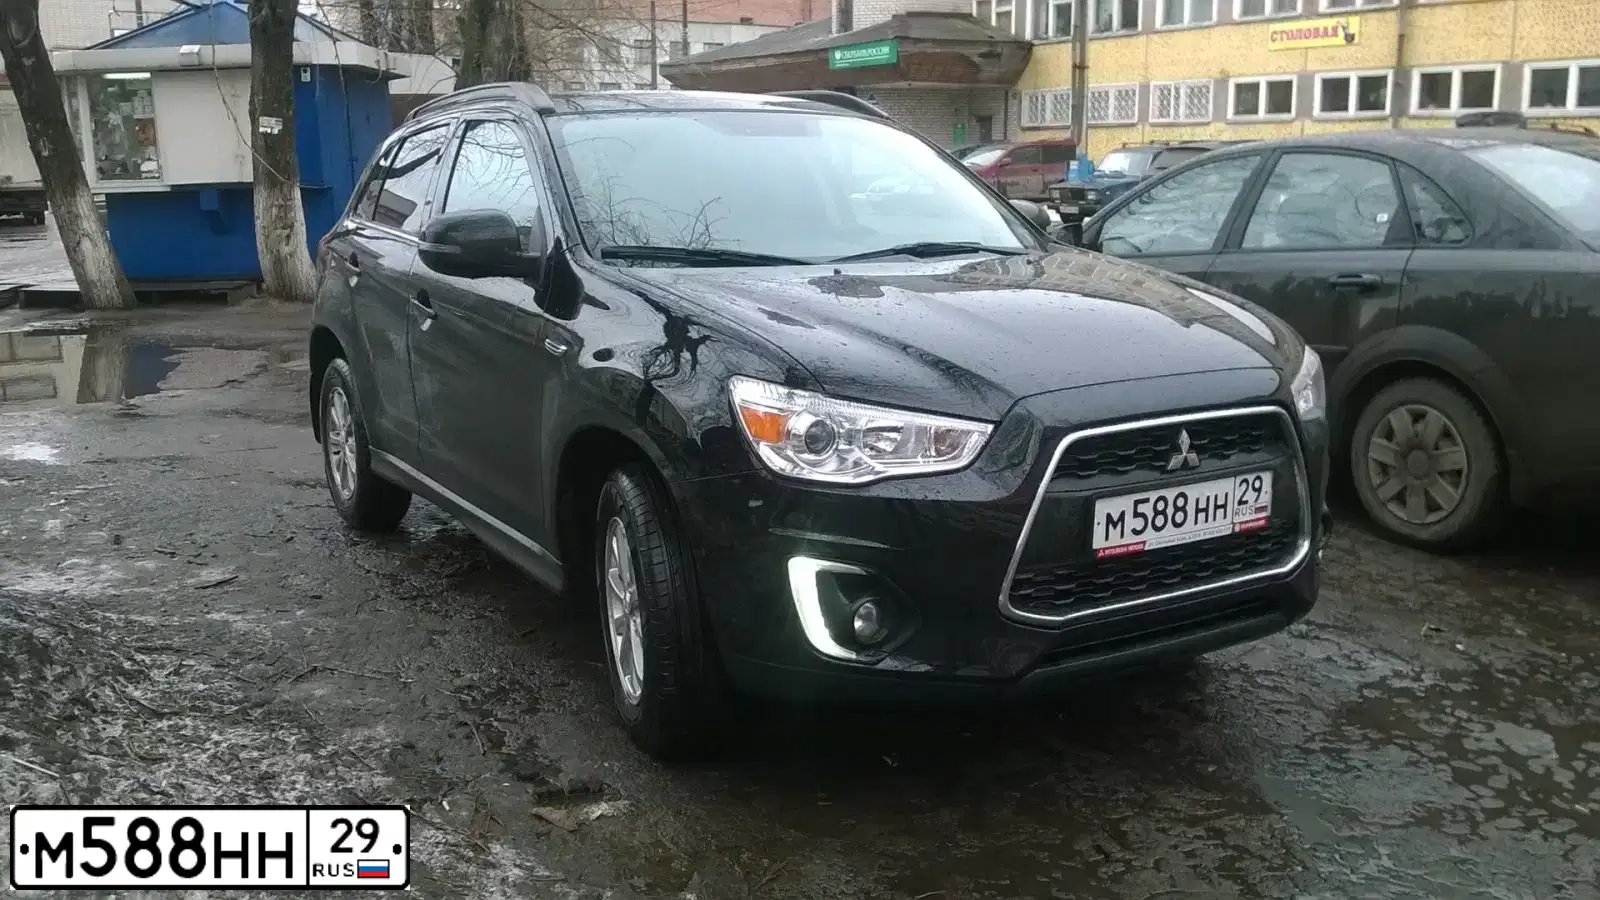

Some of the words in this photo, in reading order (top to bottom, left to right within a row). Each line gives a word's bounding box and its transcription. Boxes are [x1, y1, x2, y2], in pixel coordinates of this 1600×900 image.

[1270, 25, 1339, 42] СТОЛОВАЯ
[1104, 491, 1229, 541] М588НН
[1237, 475, 1264, 506] 29
[1235, 505, 1254, 517] RUS
